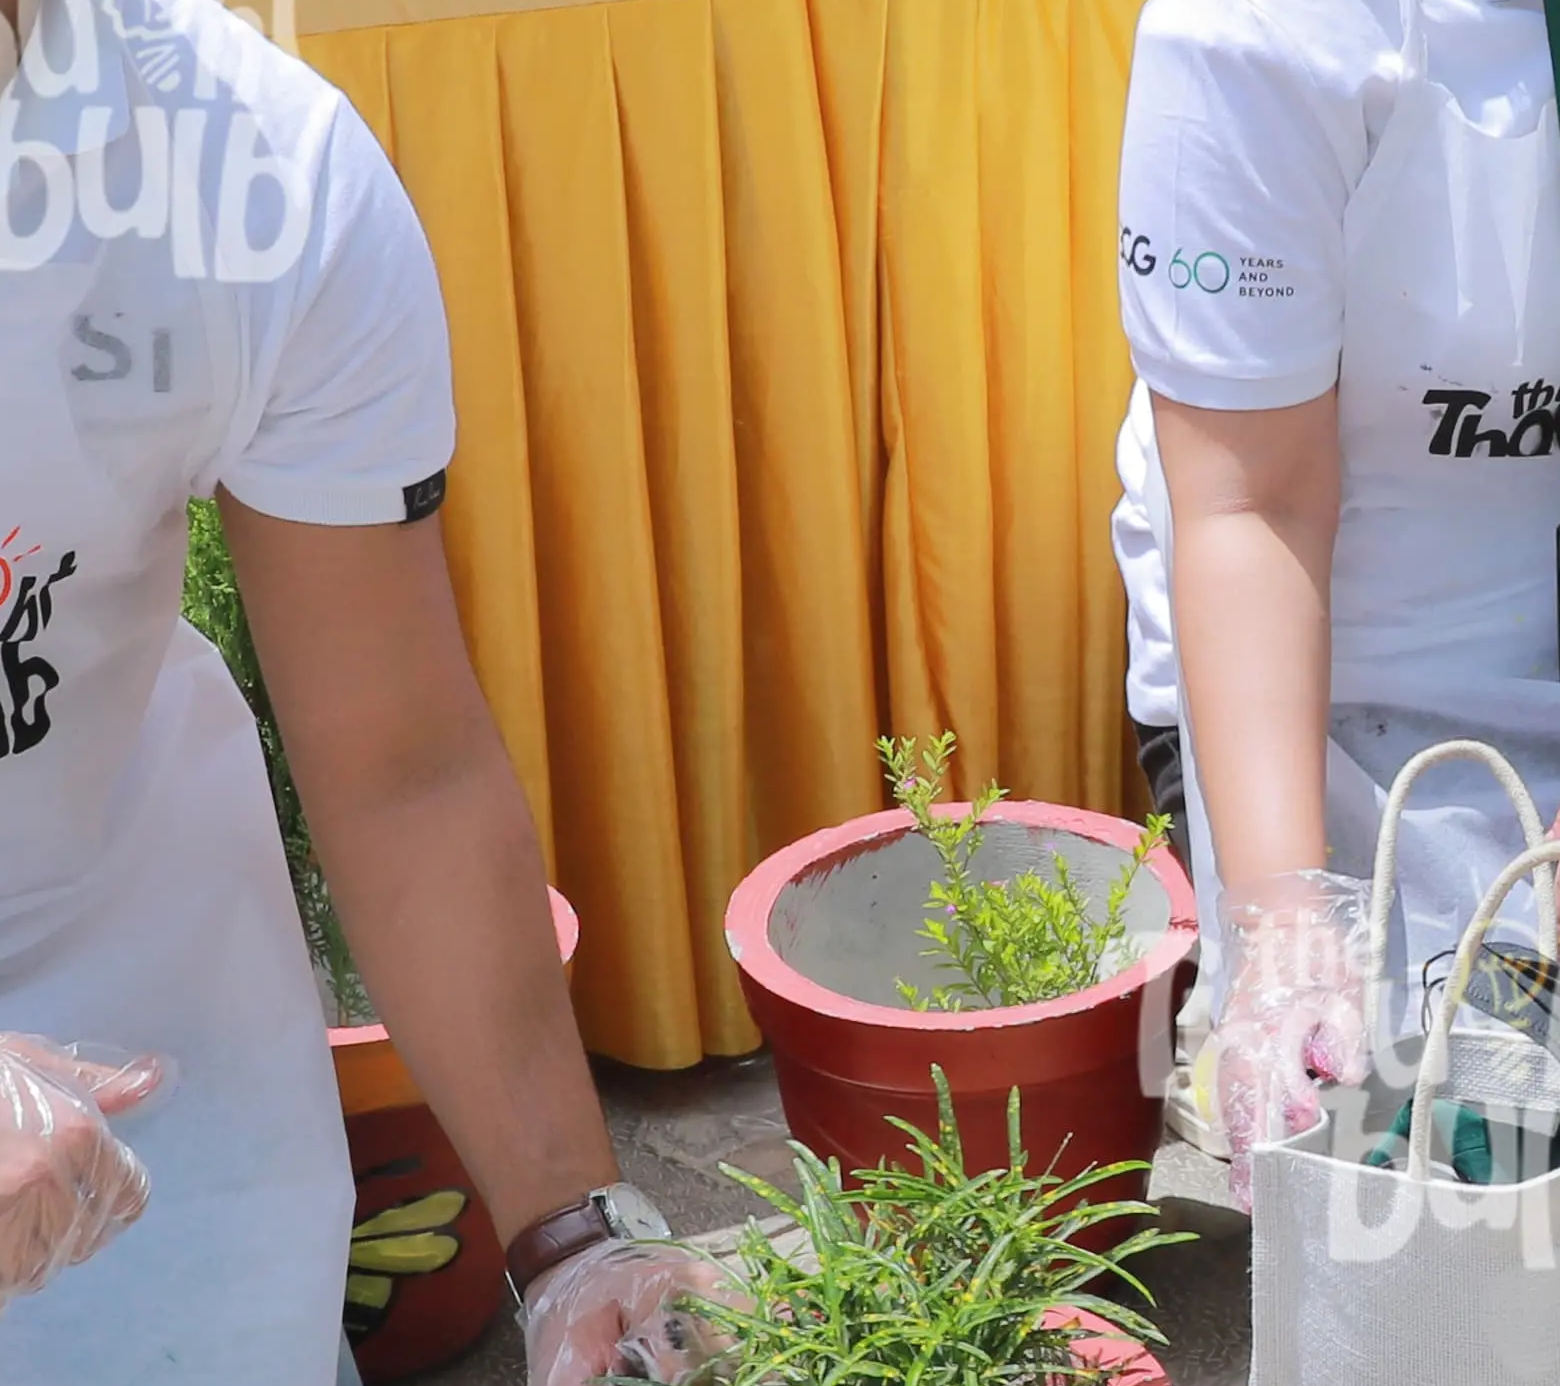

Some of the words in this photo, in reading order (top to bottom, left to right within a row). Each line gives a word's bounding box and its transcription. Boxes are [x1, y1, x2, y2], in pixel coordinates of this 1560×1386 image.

[1239, 257, 1285, 269] YEARS
[1169, 248, 1230, 294] 60
[1238, 272, 1268, 283] AND
[1239, 286, 1295, 298] BEYOND
